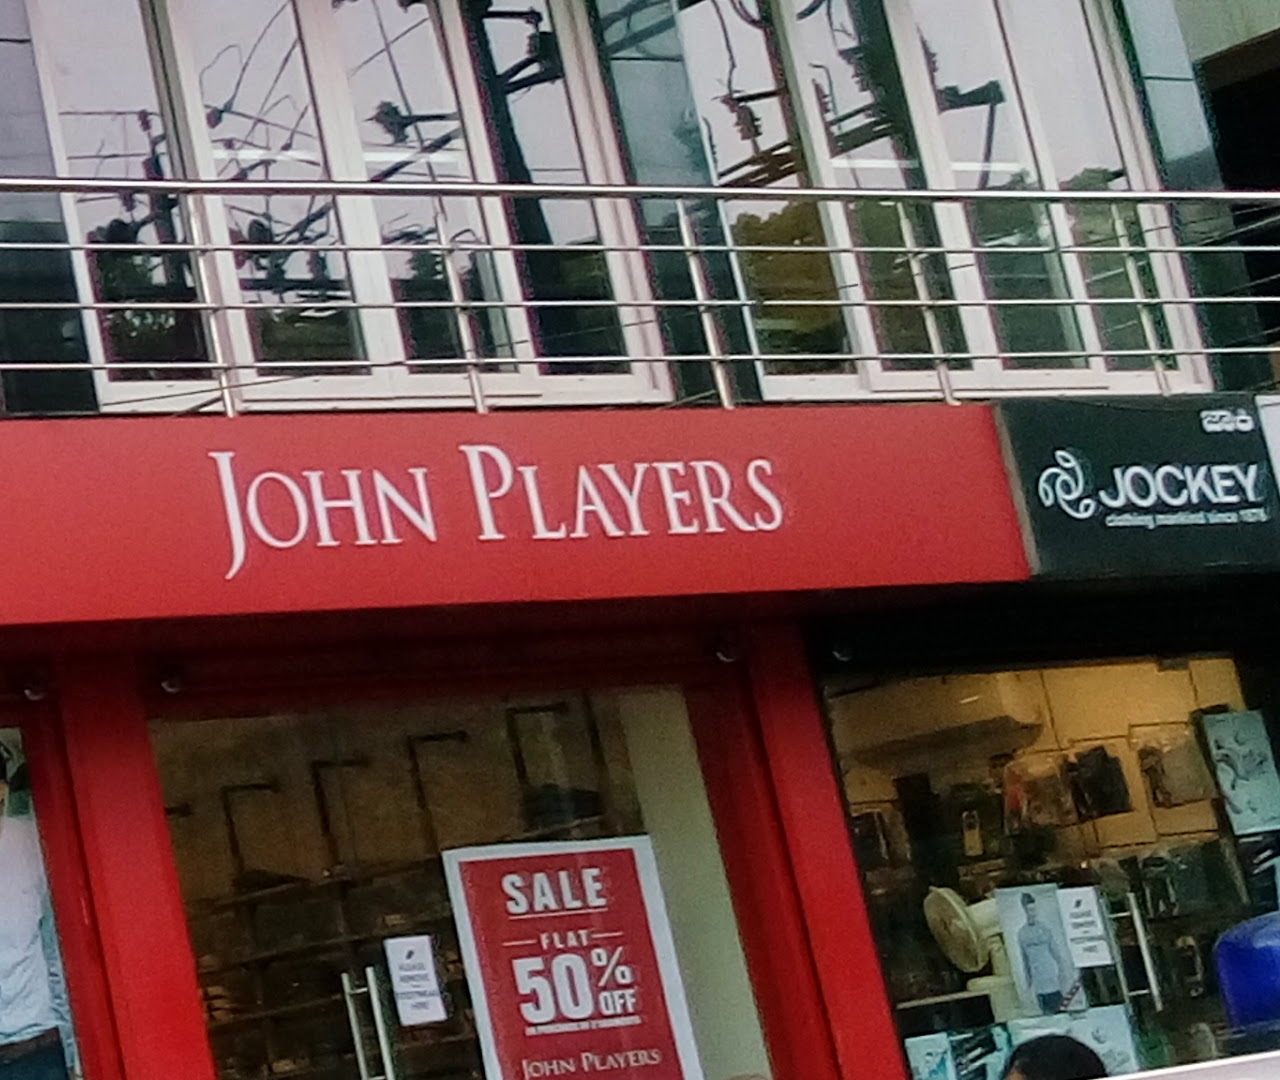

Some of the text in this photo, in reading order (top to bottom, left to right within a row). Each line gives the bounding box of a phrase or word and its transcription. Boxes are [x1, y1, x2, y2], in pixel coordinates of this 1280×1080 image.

[1099, 463, 1259, 508] JOCKEY
[207, 443, 784, 580] JOHN PLAYERS
[501, 867, 608, 915] SALE
[540, 929, 590, 951] FLAT
[597, 989, 638, 1016] OFF
[522, 1048, 662, 1080] JOHN PLAYERS
